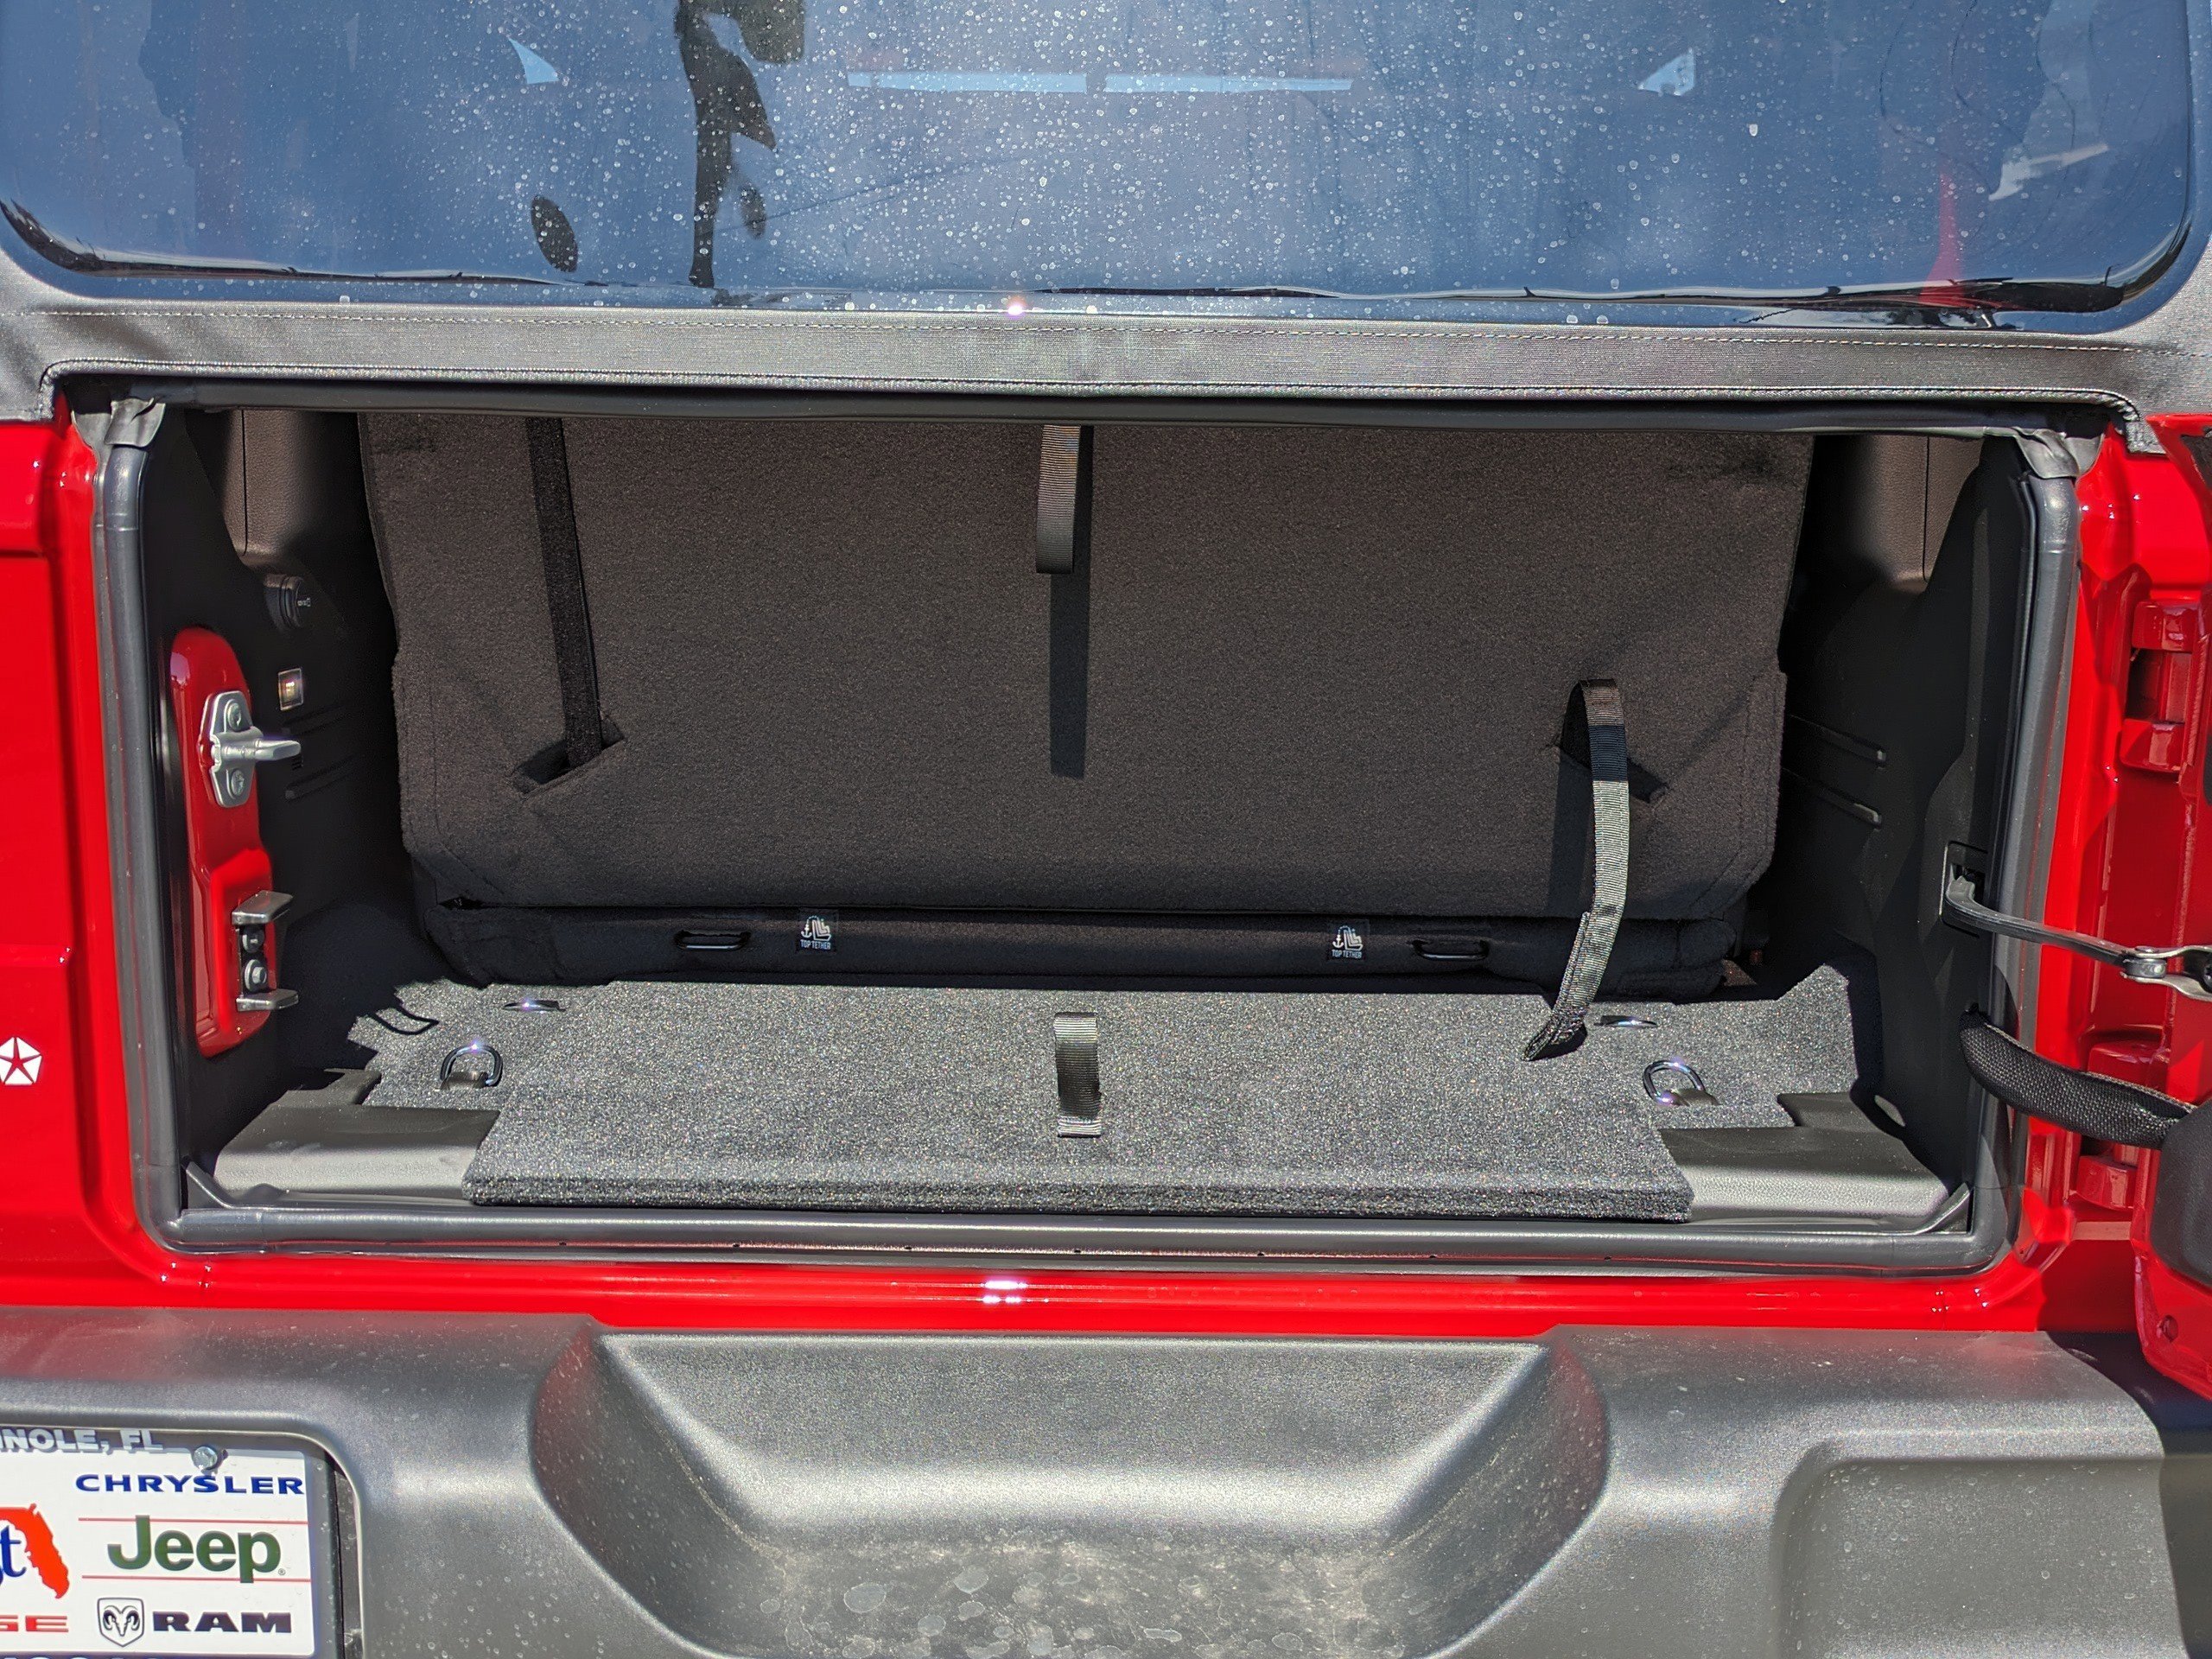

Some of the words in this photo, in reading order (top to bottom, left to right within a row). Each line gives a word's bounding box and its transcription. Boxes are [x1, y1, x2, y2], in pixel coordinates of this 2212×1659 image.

[800, 939, 811, 949] TOP
[812, 940, 831, 950] TETHER
[1343, 950, 1363, 959] TETHER
[0, 1428, 110, 1452] NOLE,
[120, 1429, 163, 1451] FL
[75, 1474, 304, 1495] CHRYSLER
[153, 1611, 292, 1634] RAM
